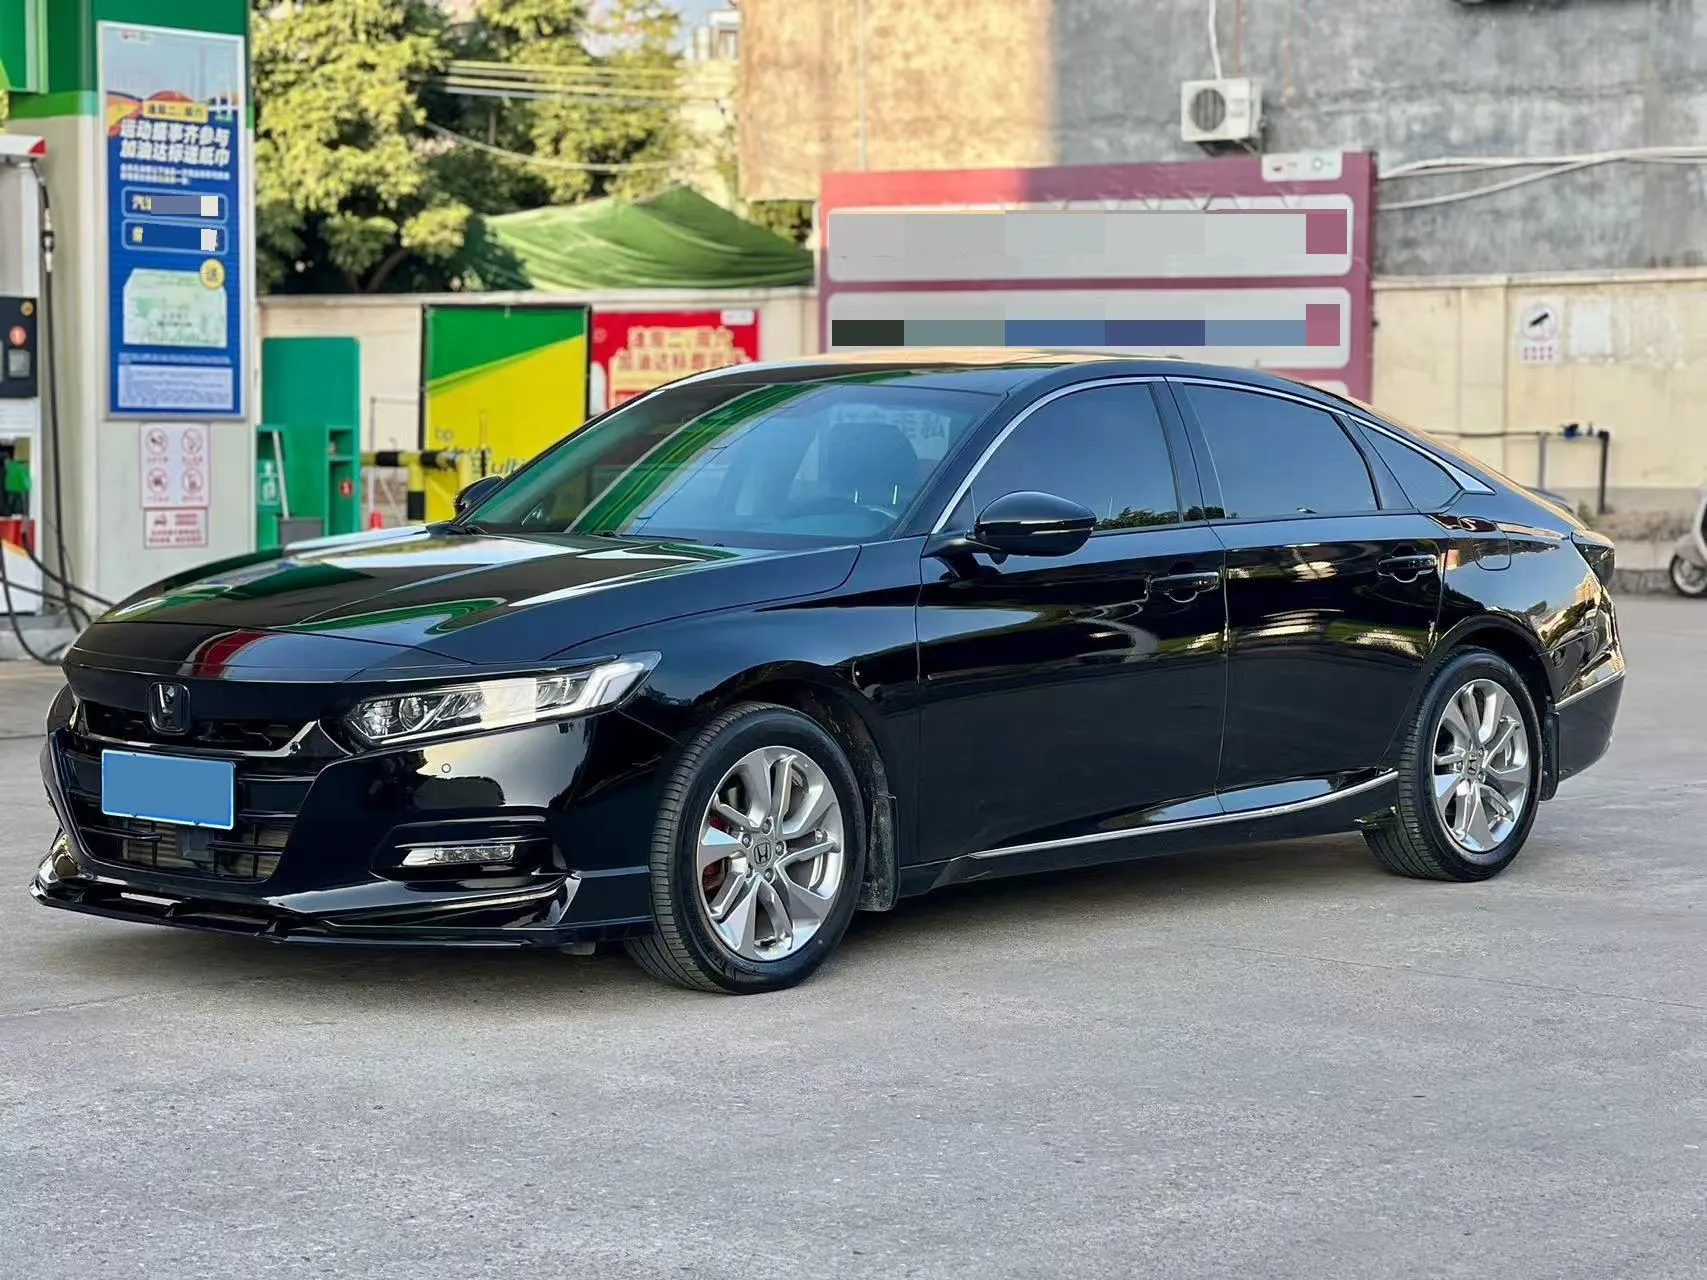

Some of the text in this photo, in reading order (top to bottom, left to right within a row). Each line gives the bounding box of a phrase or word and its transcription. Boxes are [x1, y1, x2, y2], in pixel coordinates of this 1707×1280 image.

[120, 119, 230, 147] 运动盛事齐参与
[119, 141, 230, 165] 加油达标送纸巾
